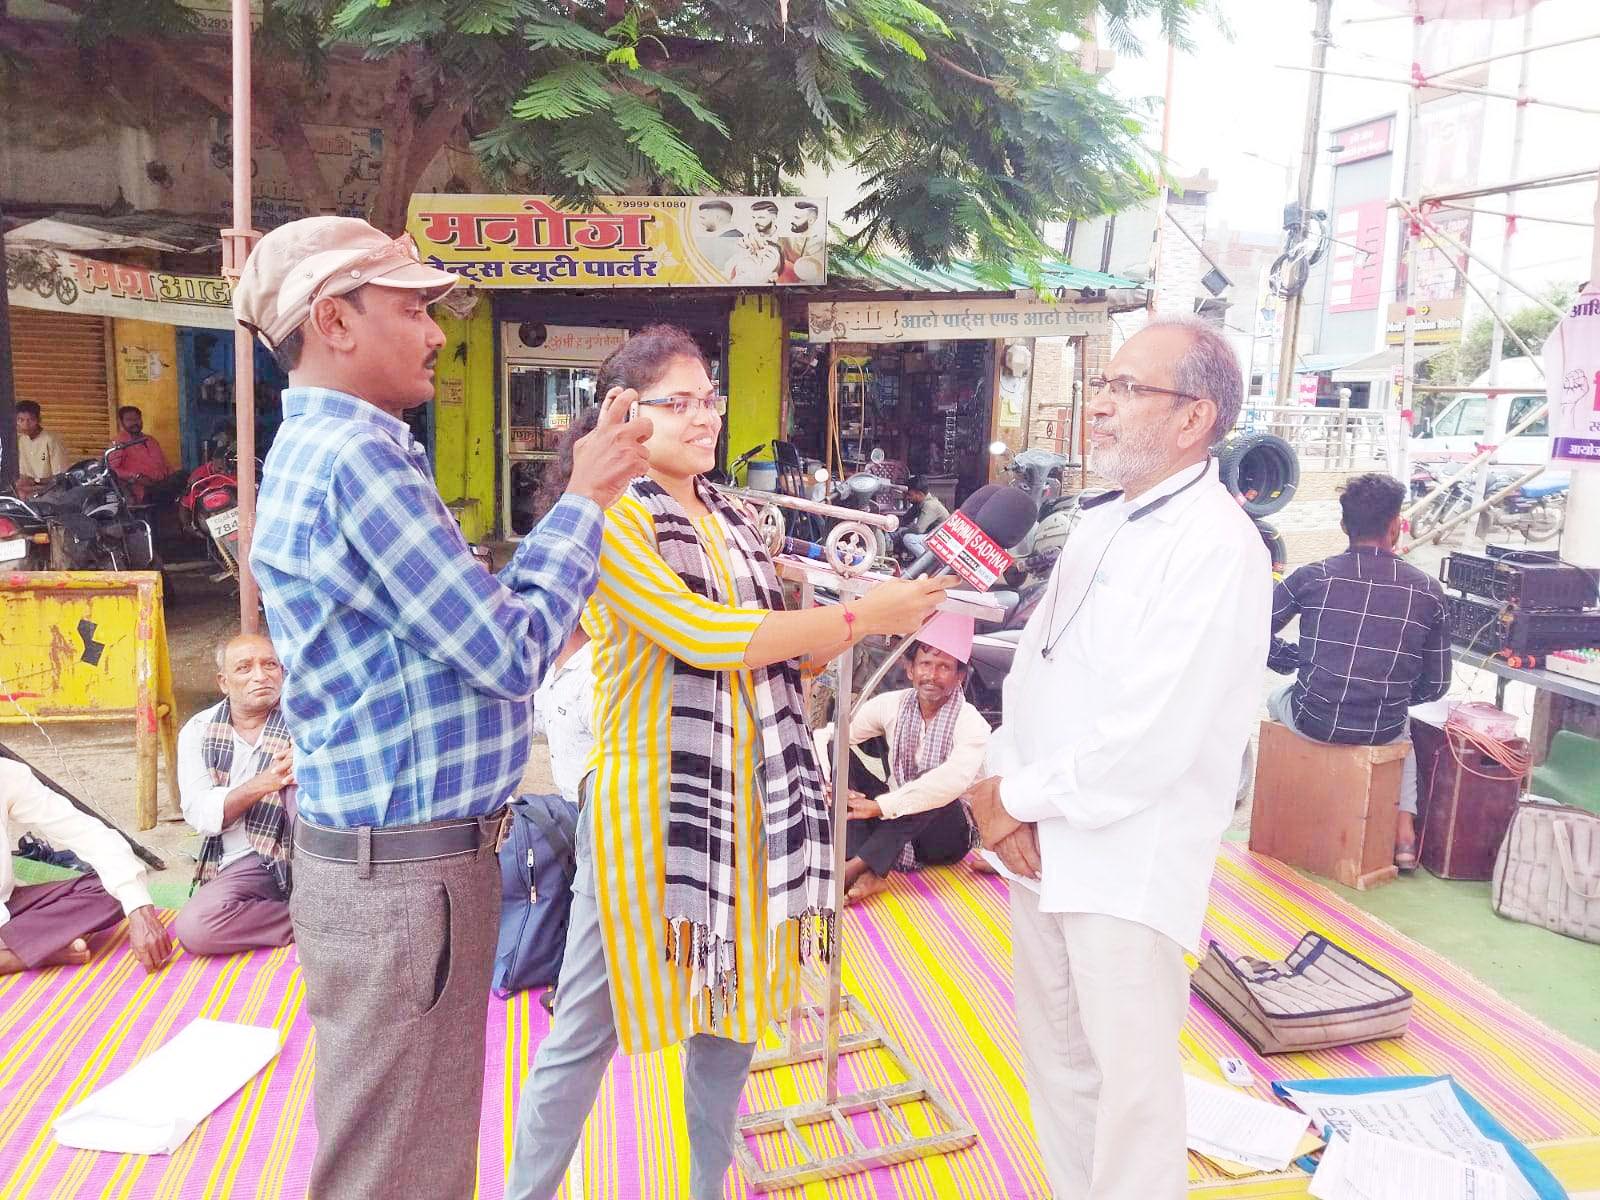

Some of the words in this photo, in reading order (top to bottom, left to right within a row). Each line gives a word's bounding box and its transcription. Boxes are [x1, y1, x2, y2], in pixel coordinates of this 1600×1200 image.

[418, 199, 655, 251] मनोज
[424, 255, 504, 281] ेन्ट्स
[509, 255, 578, 281] ब्यूटी
[583, 254, 657, 277] पार्लर
[901, 310, 938, 329] आटो
[943, 308, 985, 331] पार्ट्स
[989, 312, 1019, 327] एण्ड
[1023, 309, 1061, 326] आटो
[971, 534, 1009, 574] SADHNA
